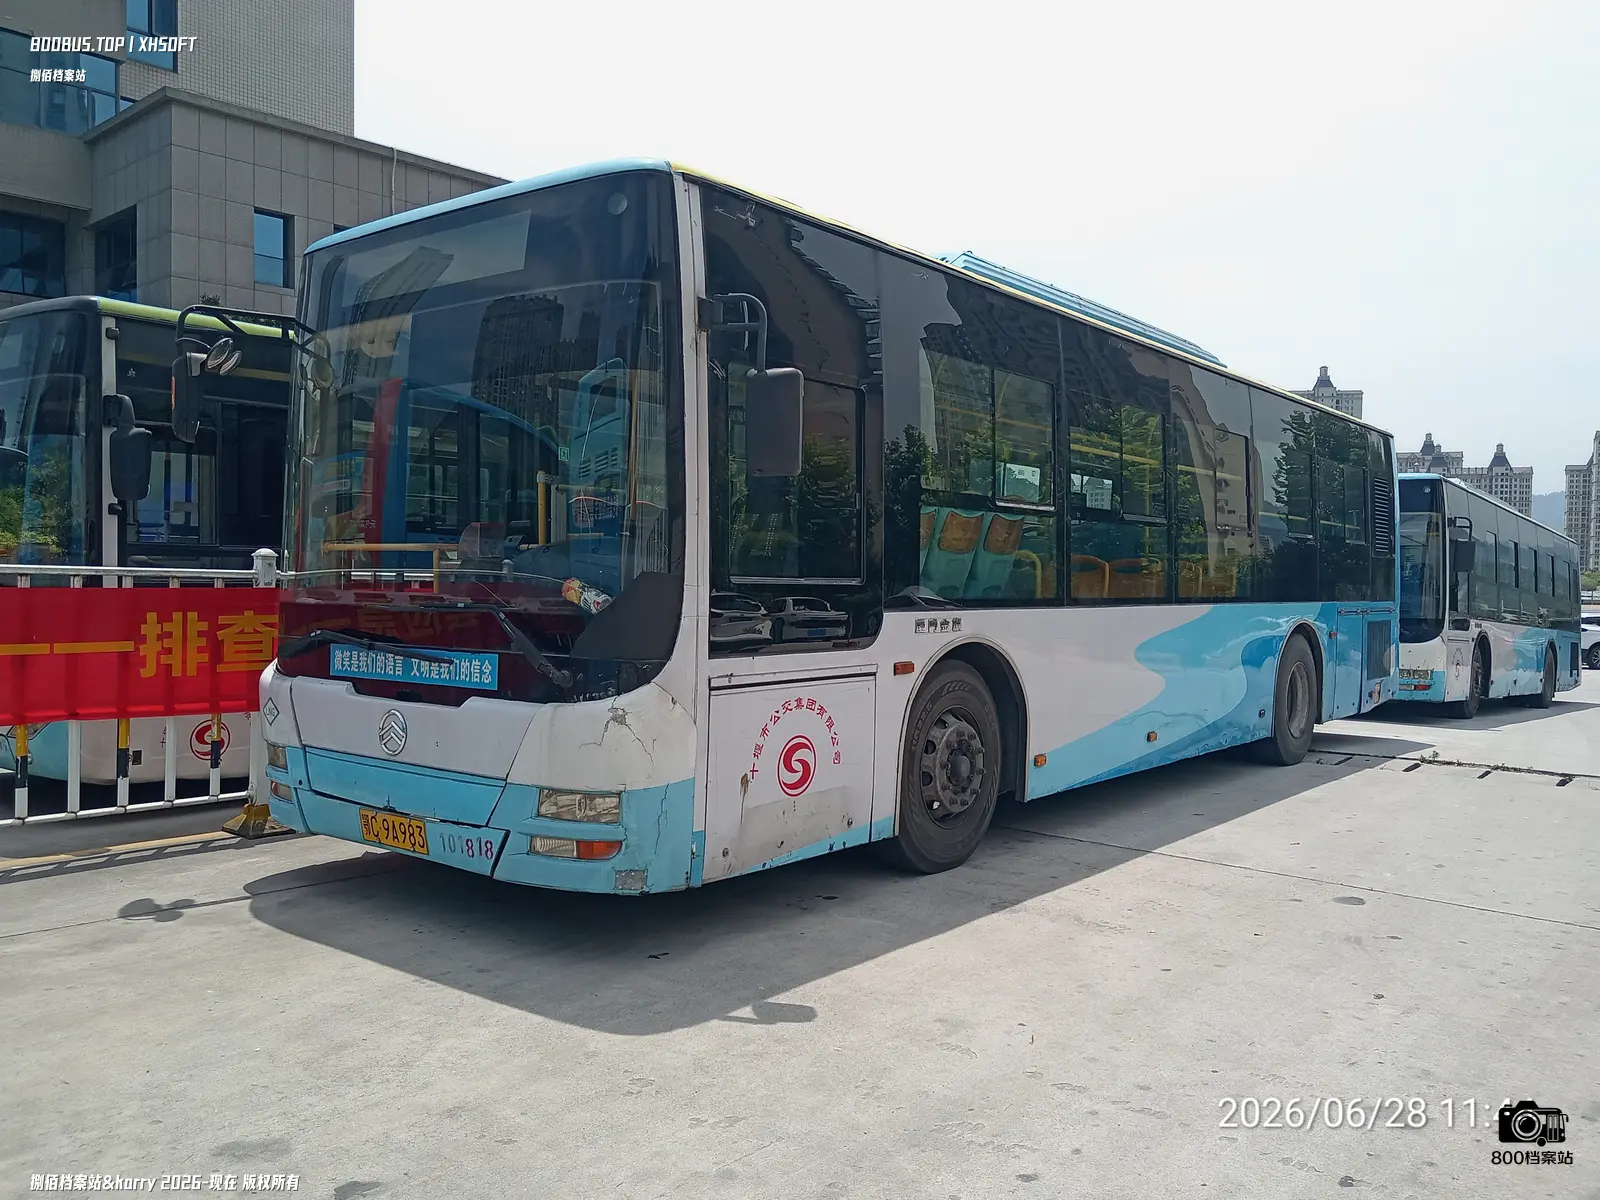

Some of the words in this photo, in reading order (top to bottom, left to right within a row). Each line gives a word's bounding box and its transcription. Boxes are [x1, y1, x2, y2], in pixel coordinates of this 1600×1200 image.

[334, 650, 404, 676] 微笑是我们的语言
[410, 656, 492, 684] 文明是我们的信念
[749, 697, 841, 780] 十堰市公交集团有限公司
